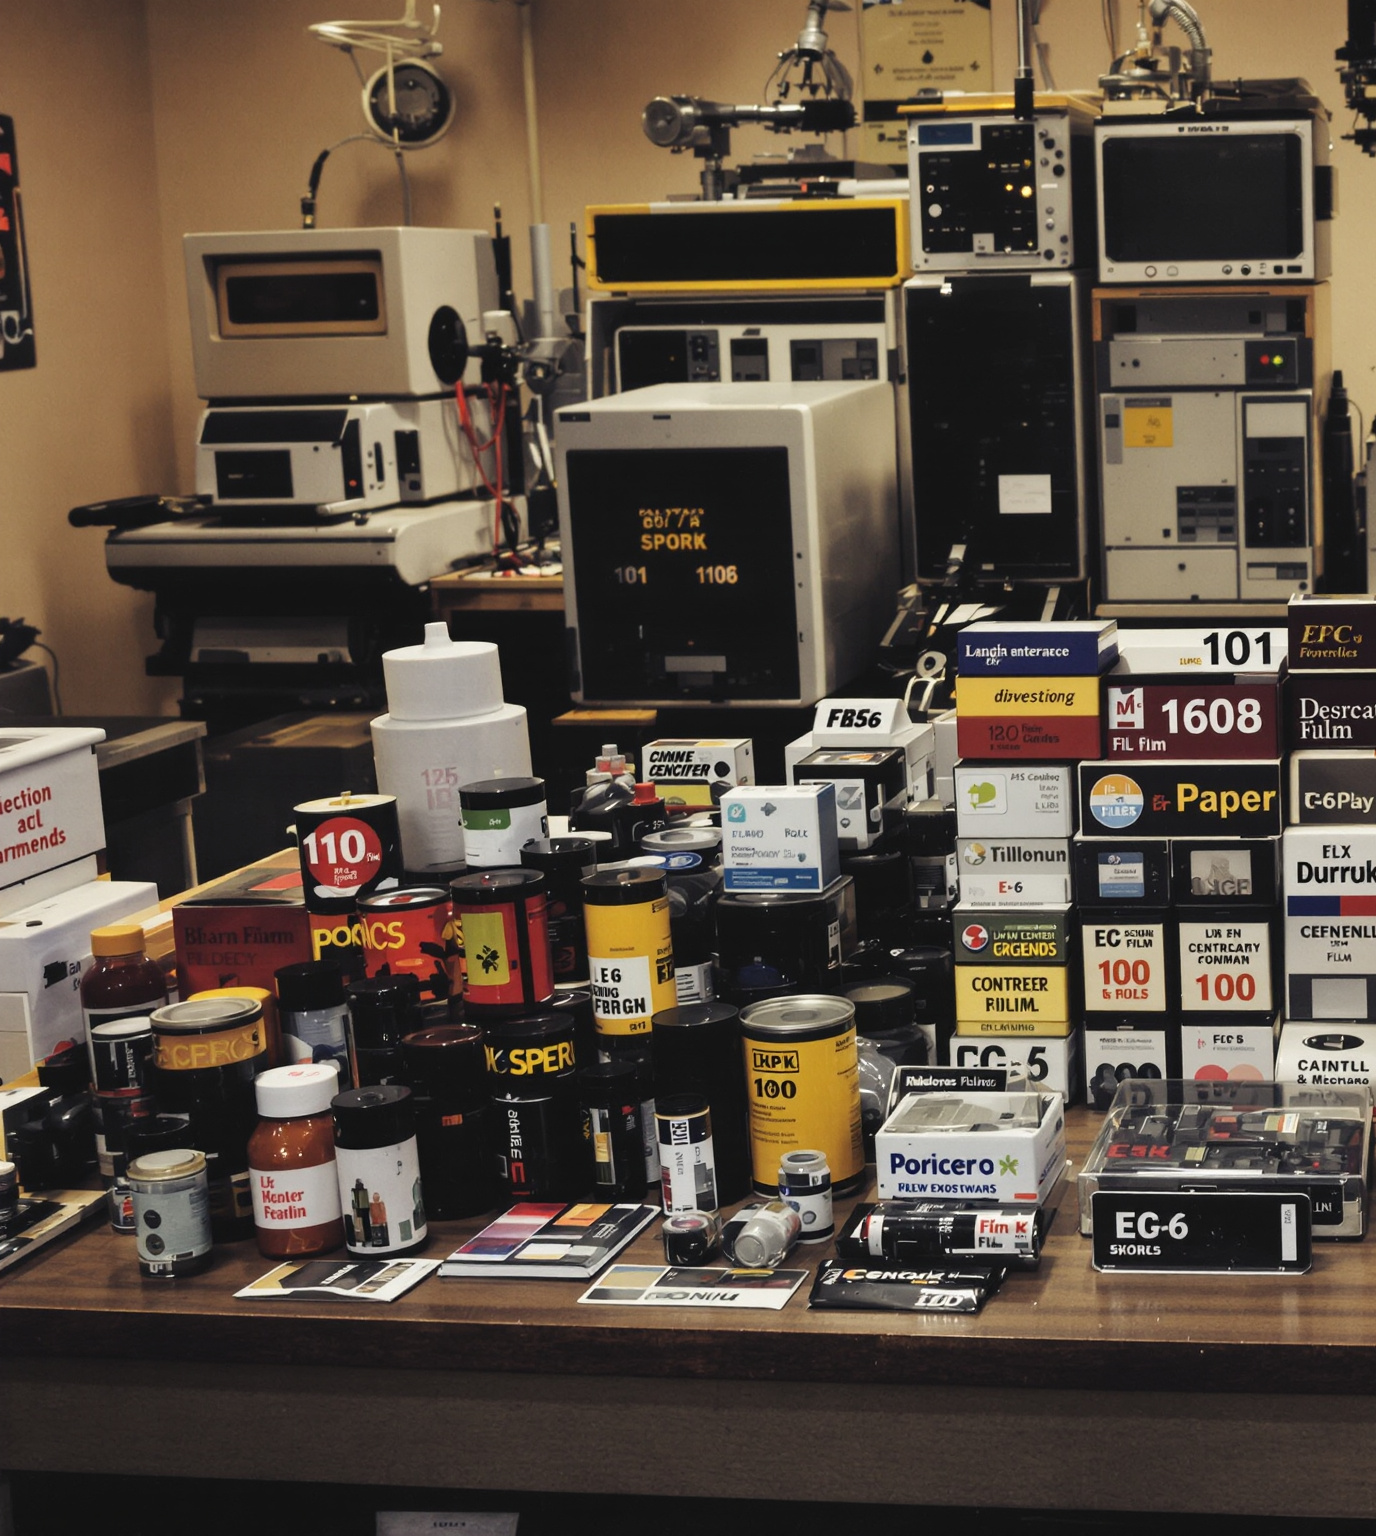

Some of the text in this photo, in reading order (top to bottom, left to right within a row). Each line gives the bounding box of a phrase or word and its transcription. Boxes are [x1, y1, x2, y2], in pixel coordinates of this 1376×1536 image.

[641, 533, 707, 550] SPORK
[696, 565, 738, 584] 1106
[1203, 631, 1271, 665] 101
[1161, 698, 1262, 734] 1608
[1176, 783, 1276, 818] Paper
[303, 829, 366, 865] 110
[1094, 929, 1122, 947] EC
[1098, 959, 1150, 986] 100
[1195, 974, 1256, 1001] 100
[754, 1078, 797, 1099] 100
[890, 1153, 995, 1176] Poricero
